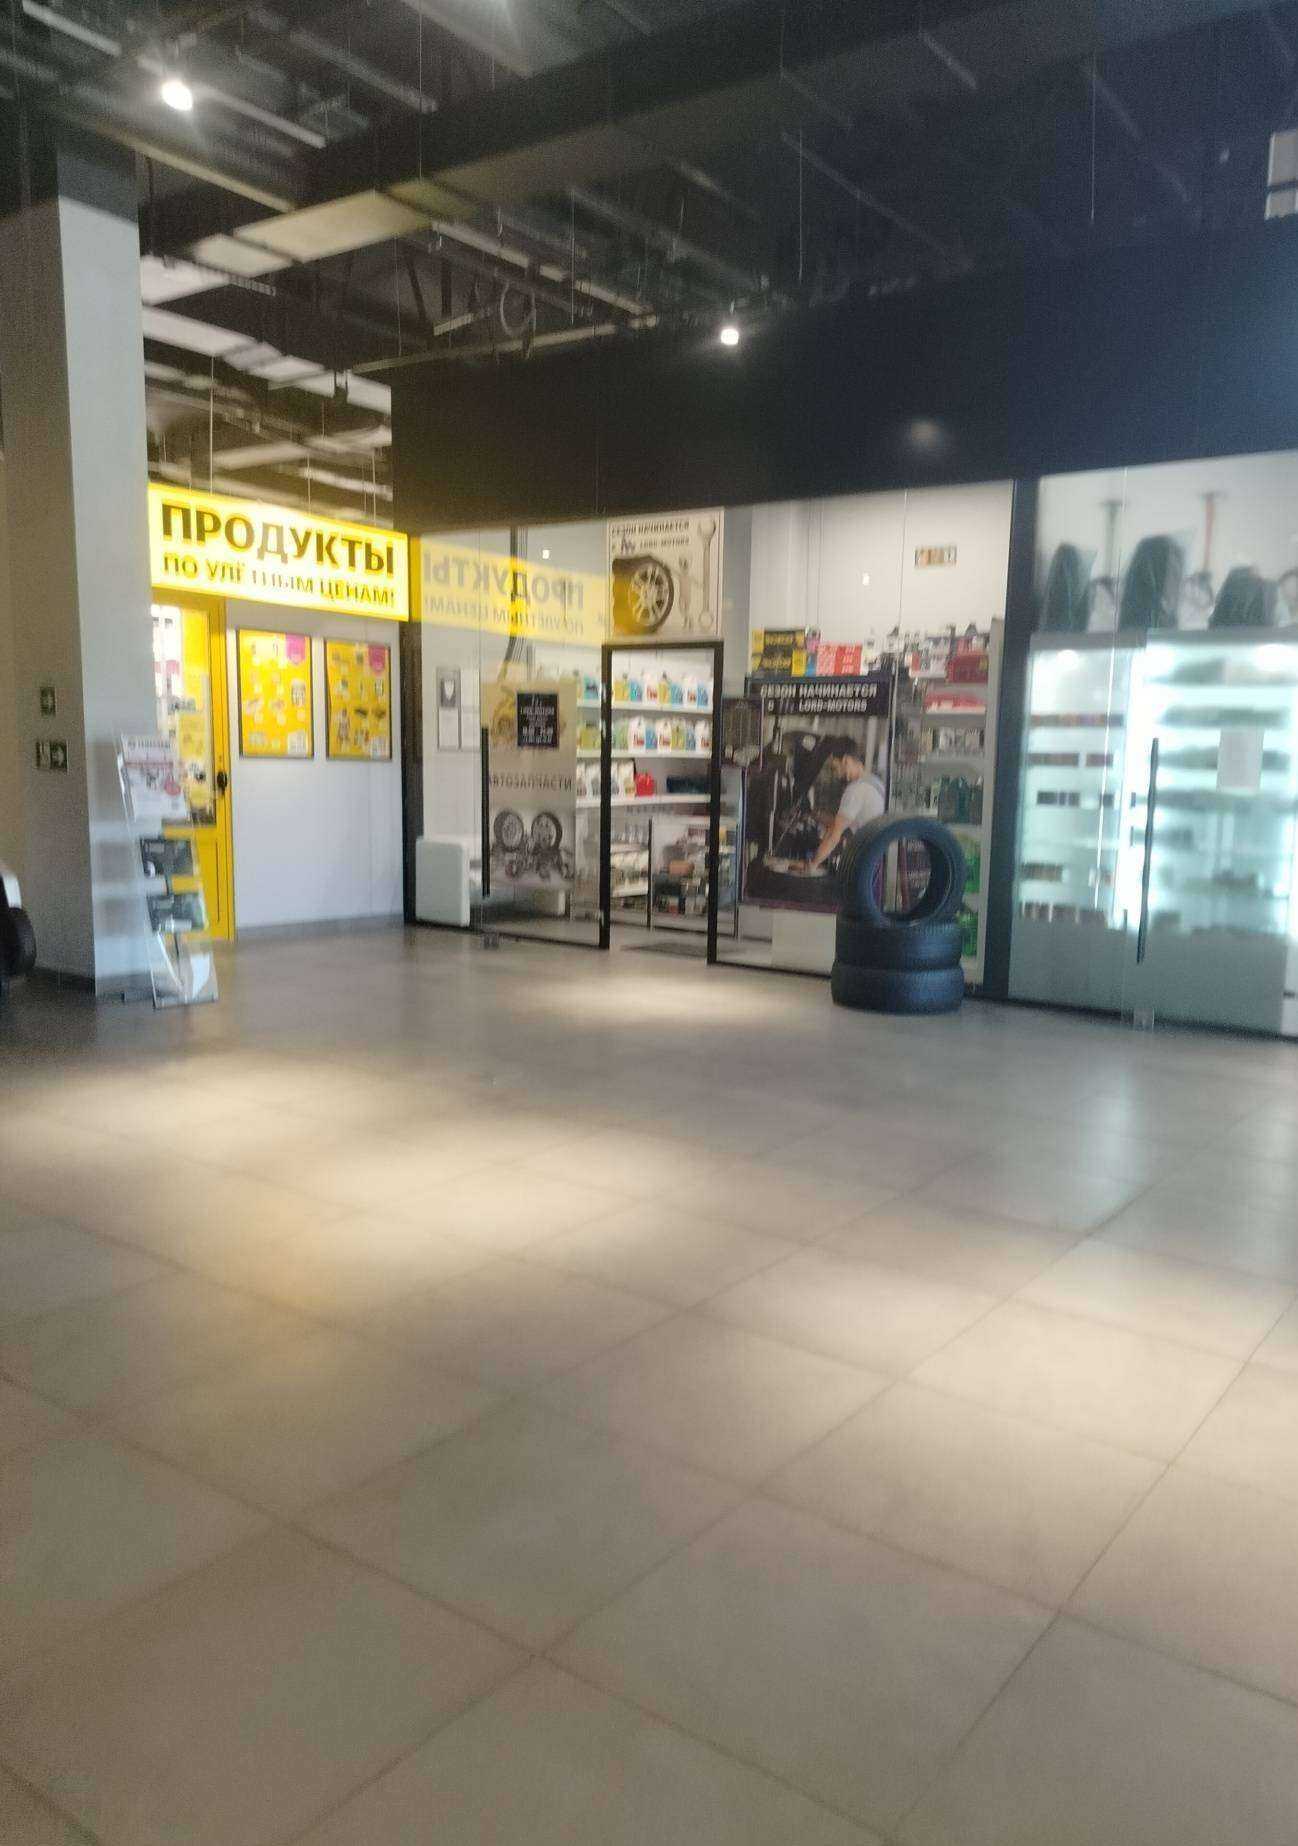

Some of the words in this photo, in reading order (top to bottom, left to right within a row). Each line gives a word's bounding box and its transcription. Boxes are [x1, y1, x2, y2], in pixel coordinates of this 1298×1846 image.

[161, 502, 394, 575] ПРОДУКТЫ
[163, 553, 199, 579] ПО
[320, 576, 395, 607] ЦЕНАМ!
